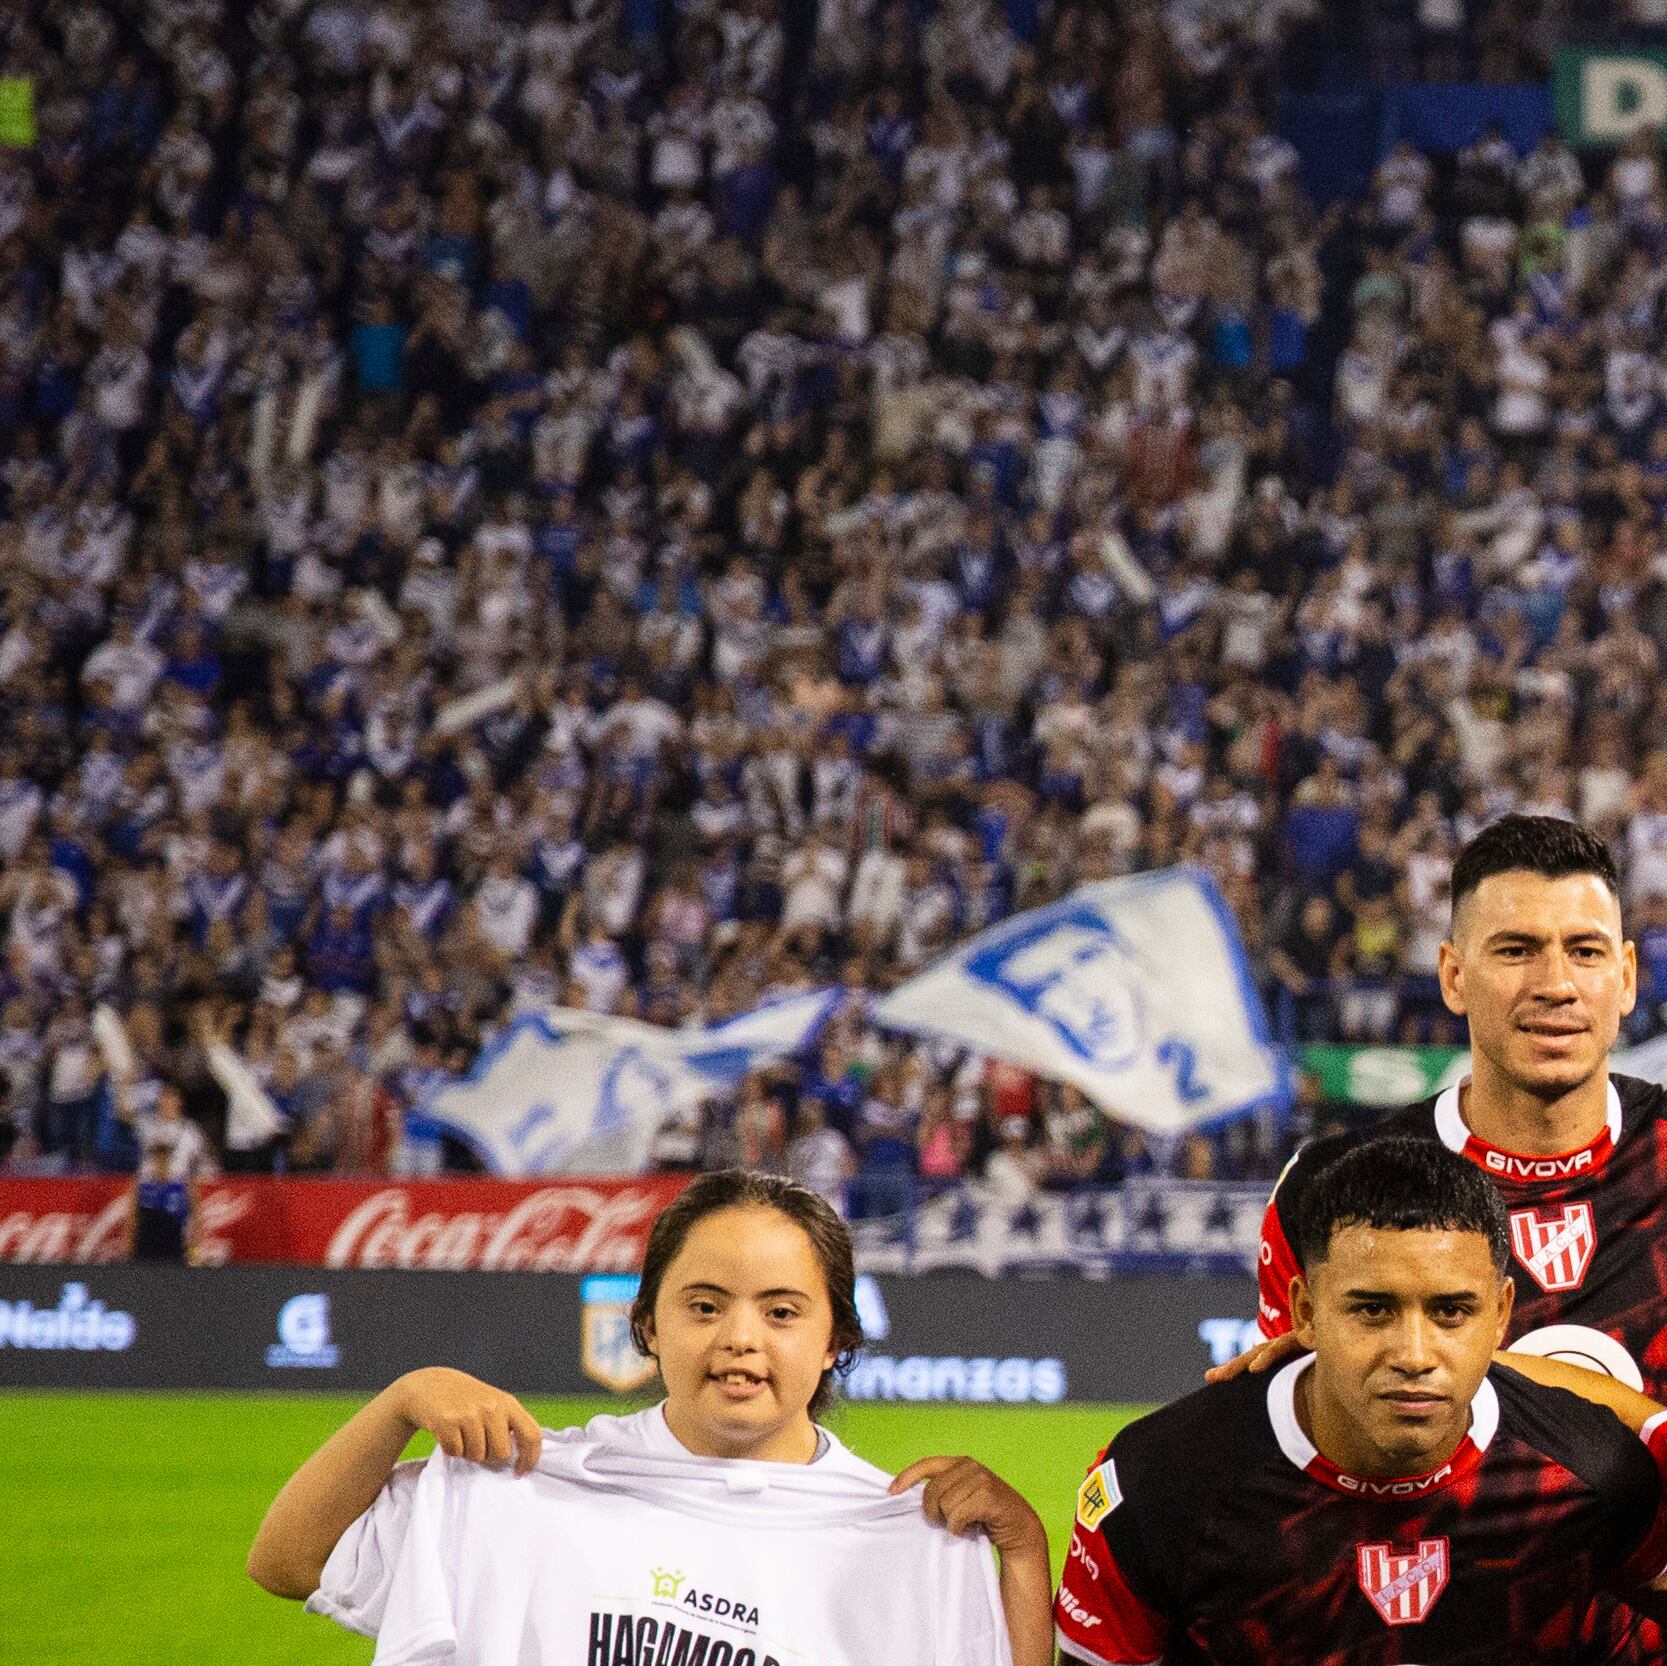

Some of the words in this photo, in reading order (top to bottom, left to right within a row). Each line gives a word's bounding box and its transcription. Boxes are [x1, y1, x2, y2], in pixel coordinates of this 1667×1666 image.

[1485, 1149, 1593, 1177] GIVOVA
[1337, 1464, 1452, 1495] GIVOVA
[683, 1588, 760, 1626] ASDRA
